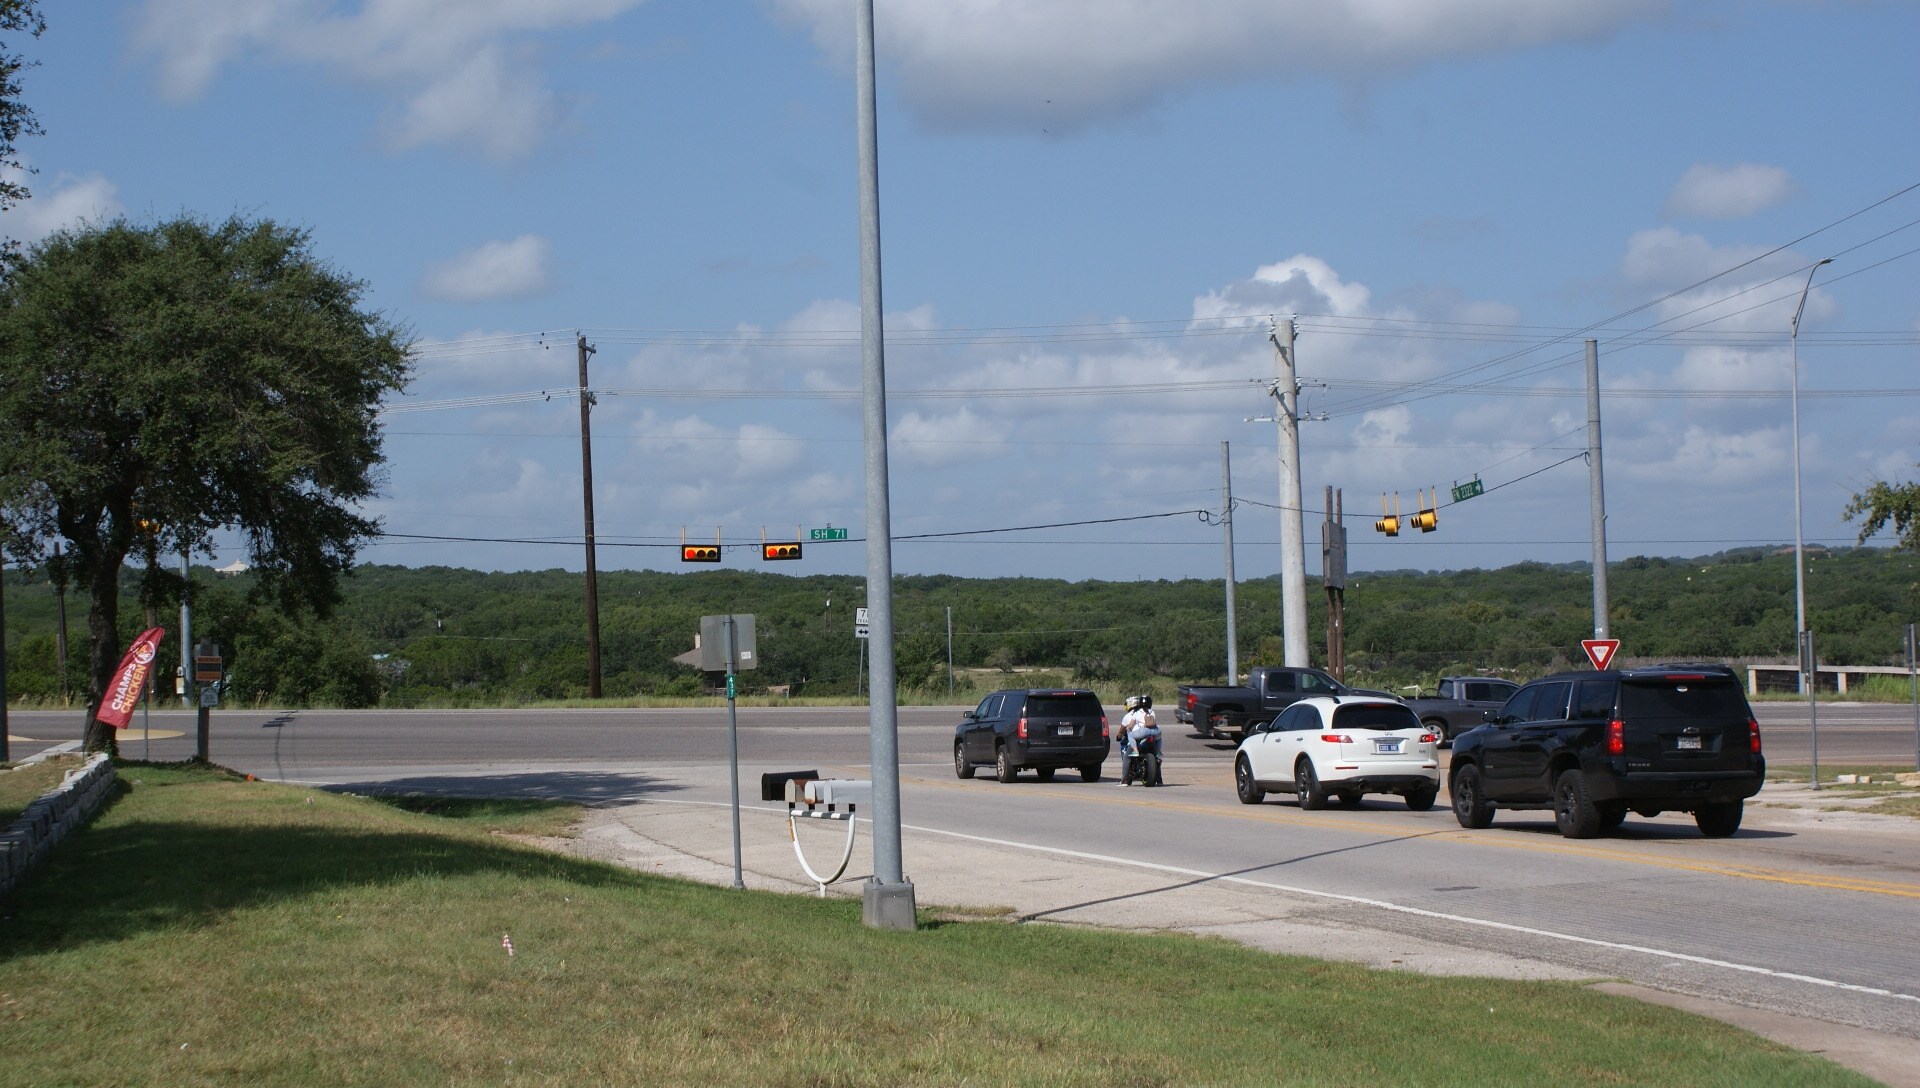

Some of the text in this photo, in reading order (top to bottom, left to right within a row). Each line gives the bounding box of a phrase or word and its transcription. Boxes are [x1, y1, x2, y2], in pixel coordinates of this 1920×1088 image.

[1460, 484, 1474, 499] 2322
[814, 529, 845, 539] SH 71
[111, 663, 136, 711] CHAMPS
[121, 664, 147, 714] CHICKEN
